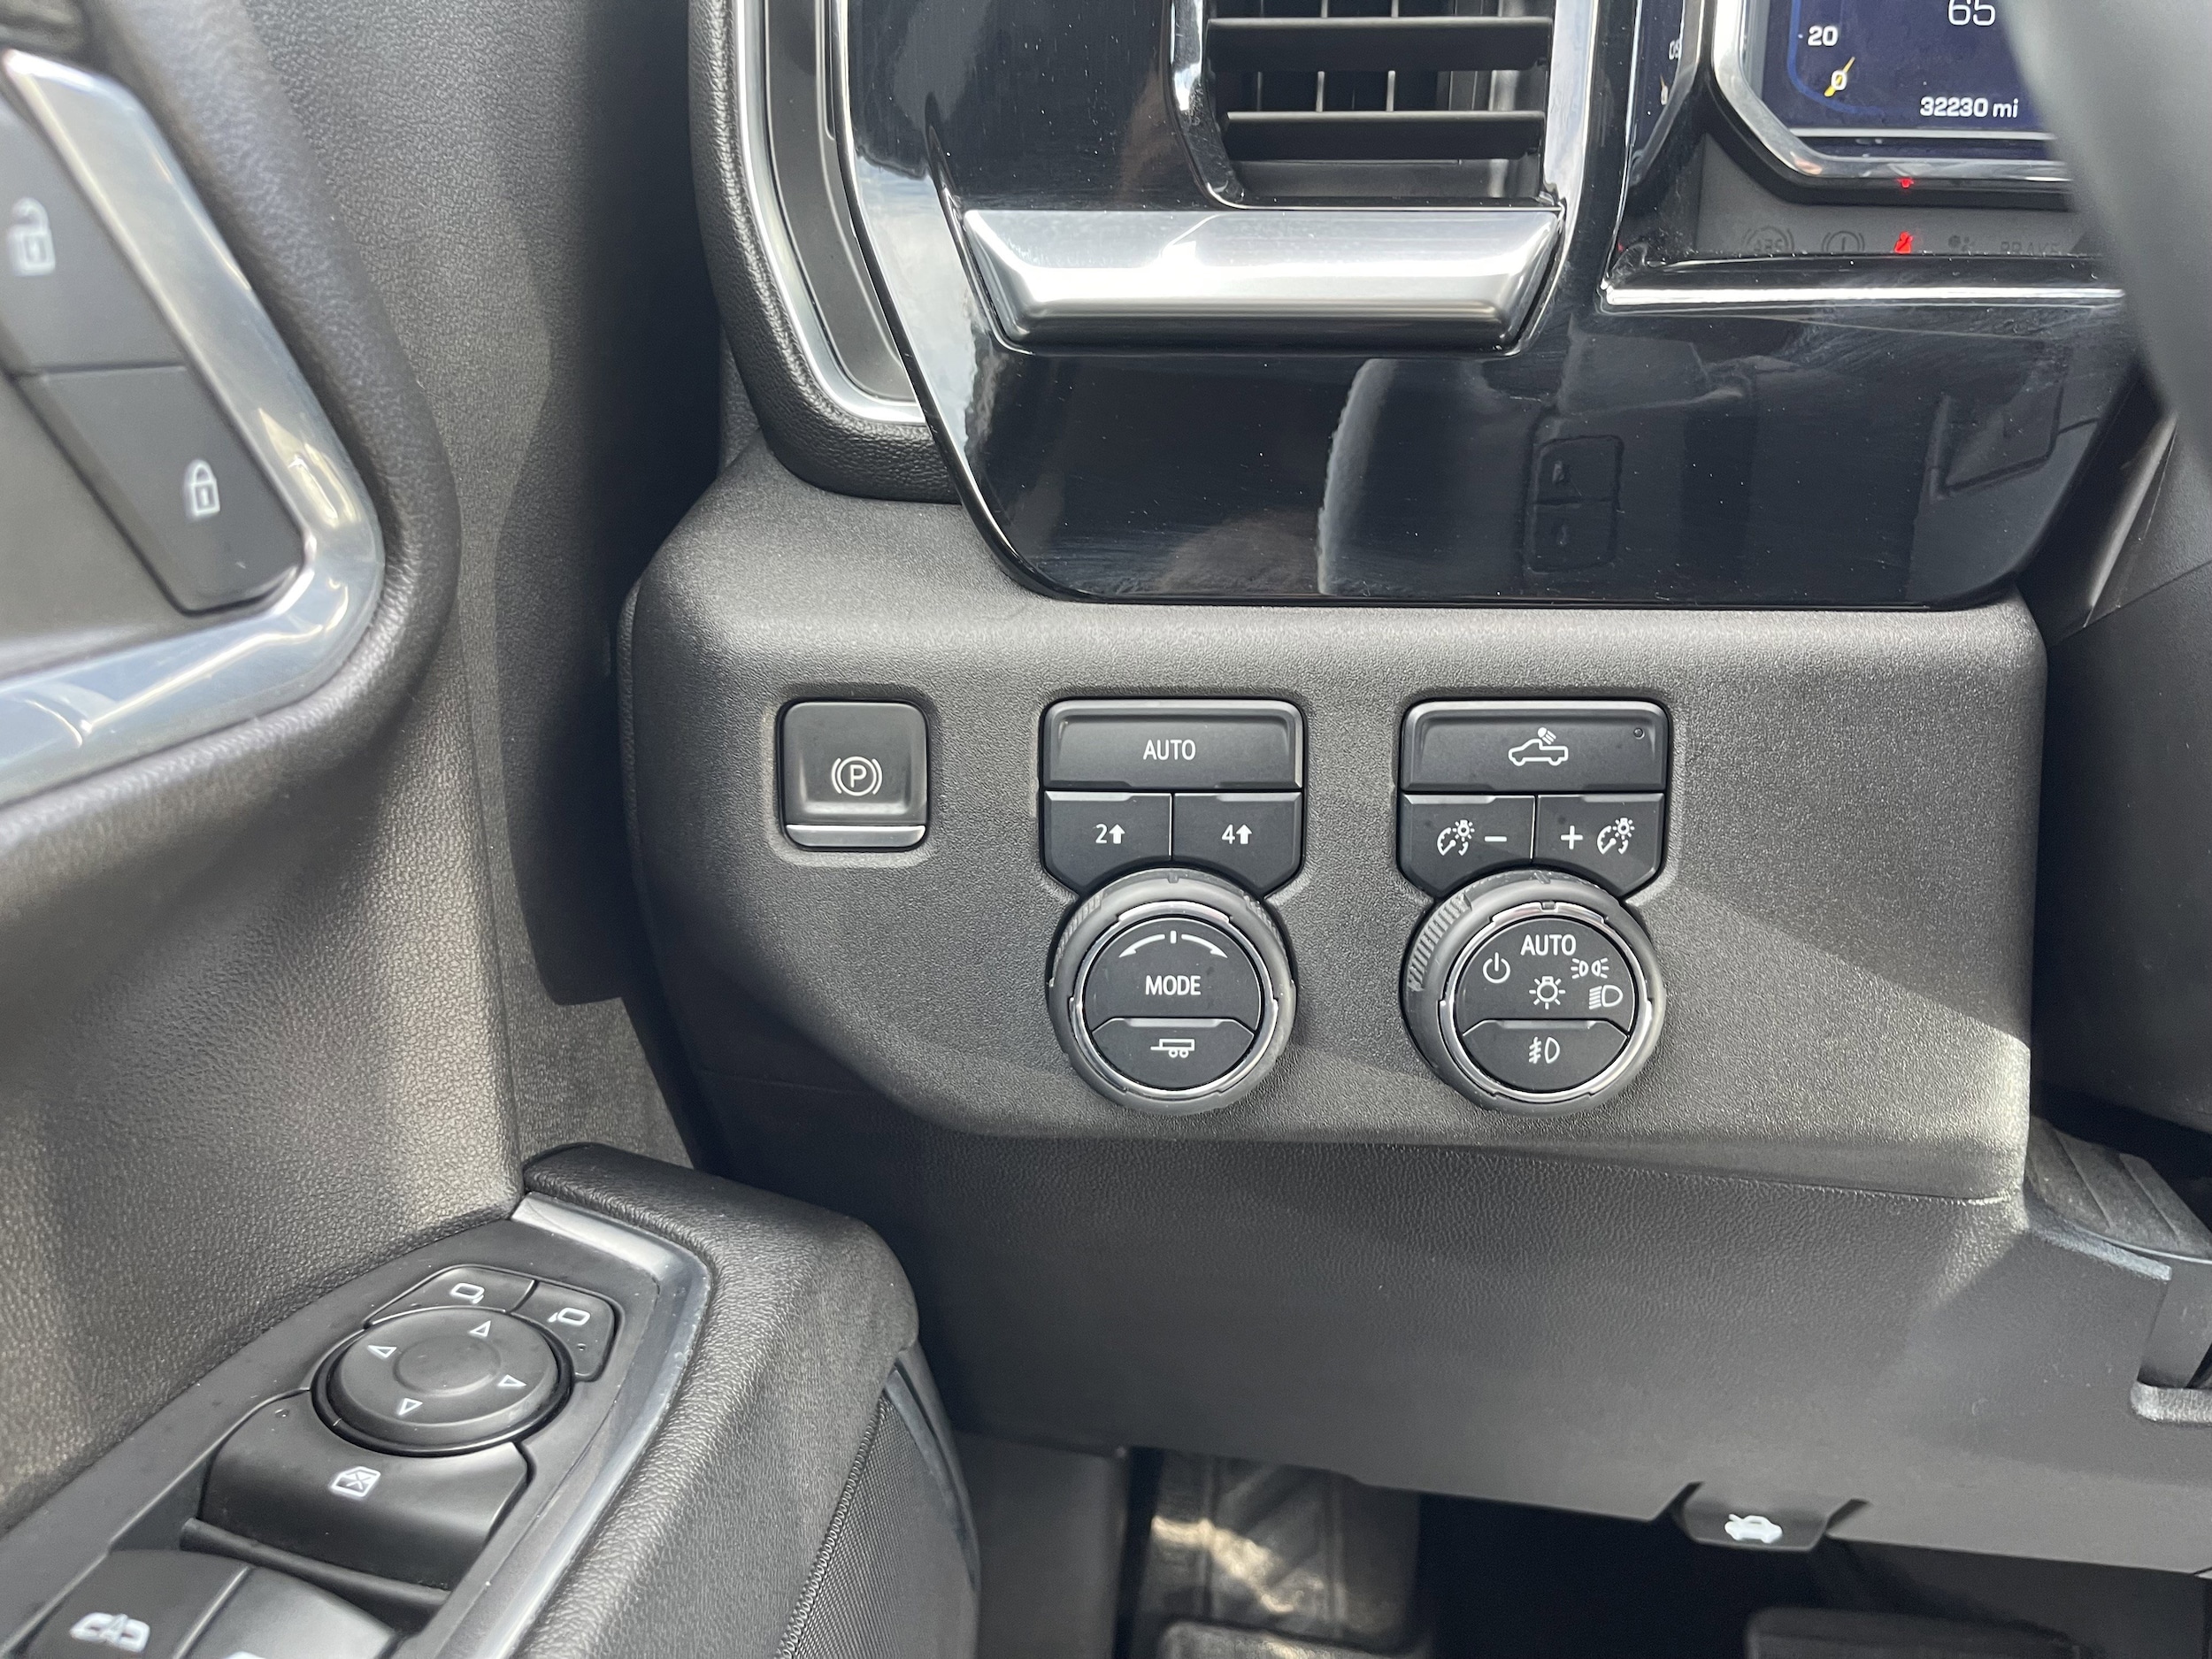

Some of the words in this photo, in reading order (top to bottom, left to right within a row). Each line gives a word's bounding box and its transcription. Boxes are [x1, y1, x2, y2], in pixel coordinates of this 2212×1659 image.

[1948, 0, 1996, 26] 65
[1807, 25, 1839, 46] 20
[1919, 96, 1989, 118] 32230
[1992, 98, 2019, 118] mi
[1142, 739, 1196, 761] AUTO
[849, 764, 867, 788] P
[1094, 824, 1108, 844] 2
[1221, 824, 1235, 844] 4
[1520, 933, 1578, 956] AUTO
[1145, 975, 1202, 996] MODE
